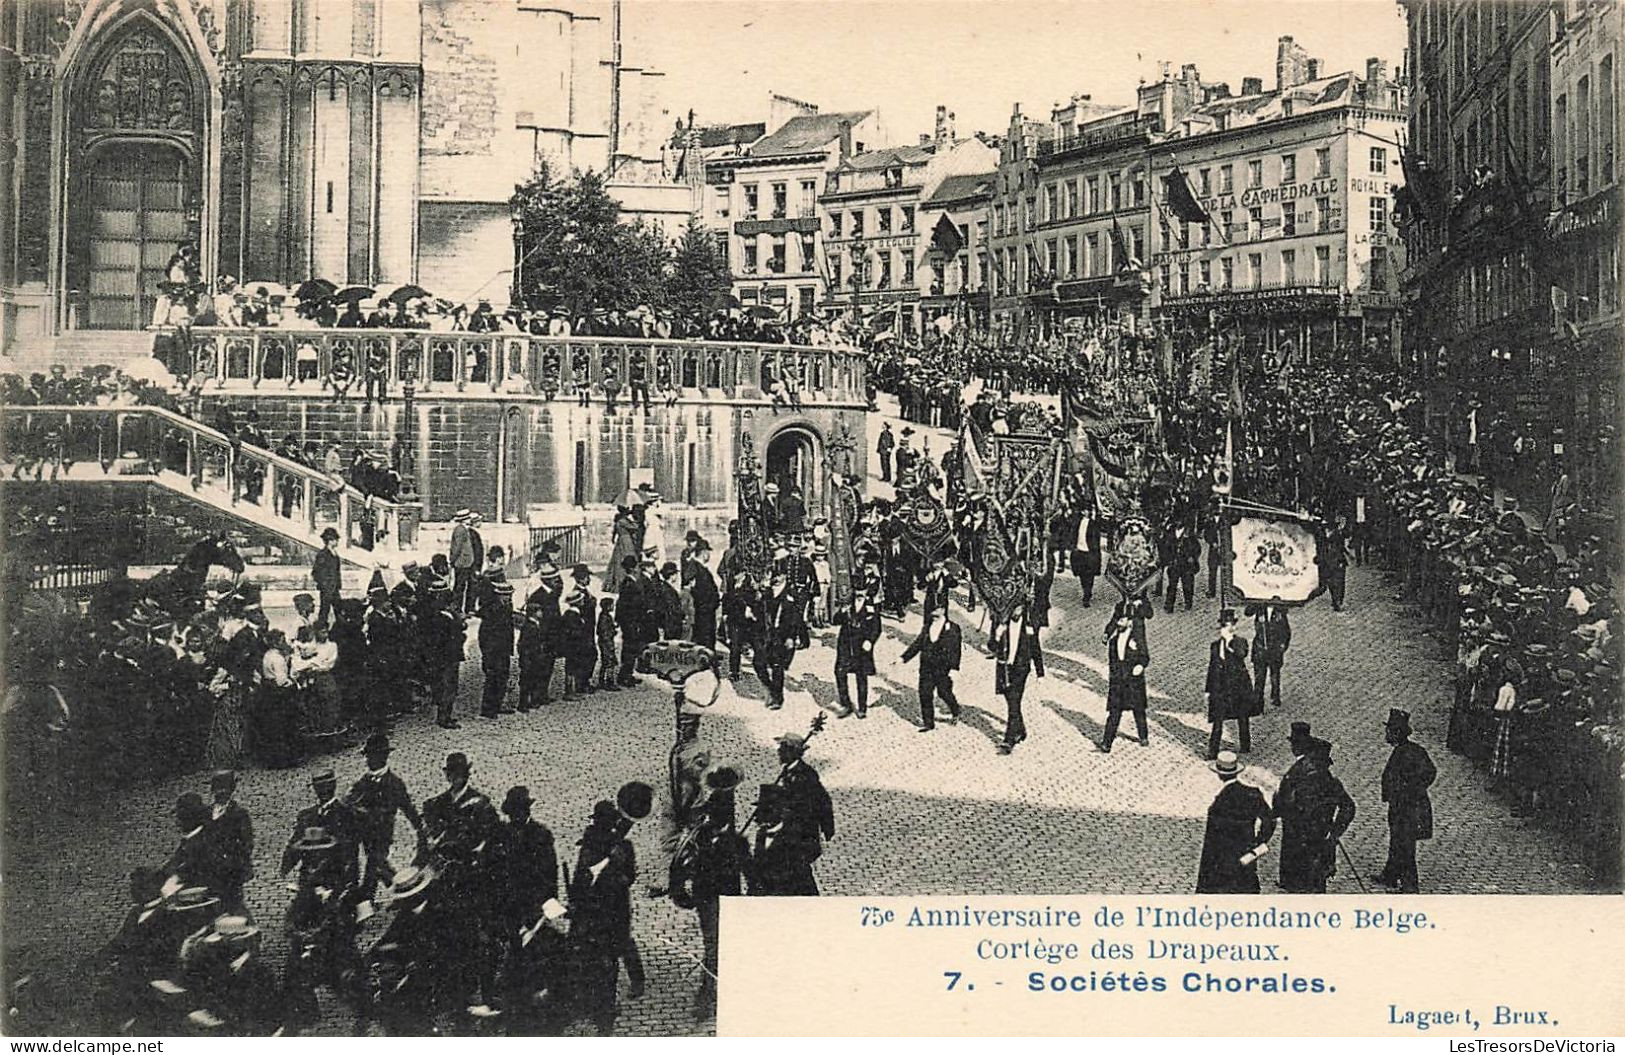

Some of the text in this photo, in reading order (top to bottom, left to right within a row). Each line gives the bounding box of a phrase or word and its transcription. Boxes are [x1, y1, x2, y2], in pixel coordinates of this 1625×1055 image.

[1351, 178, 1379, 194] ROYAL
[1220, 196, 1238, 210] LA
[1354, 233, 1383, 246] LACE
